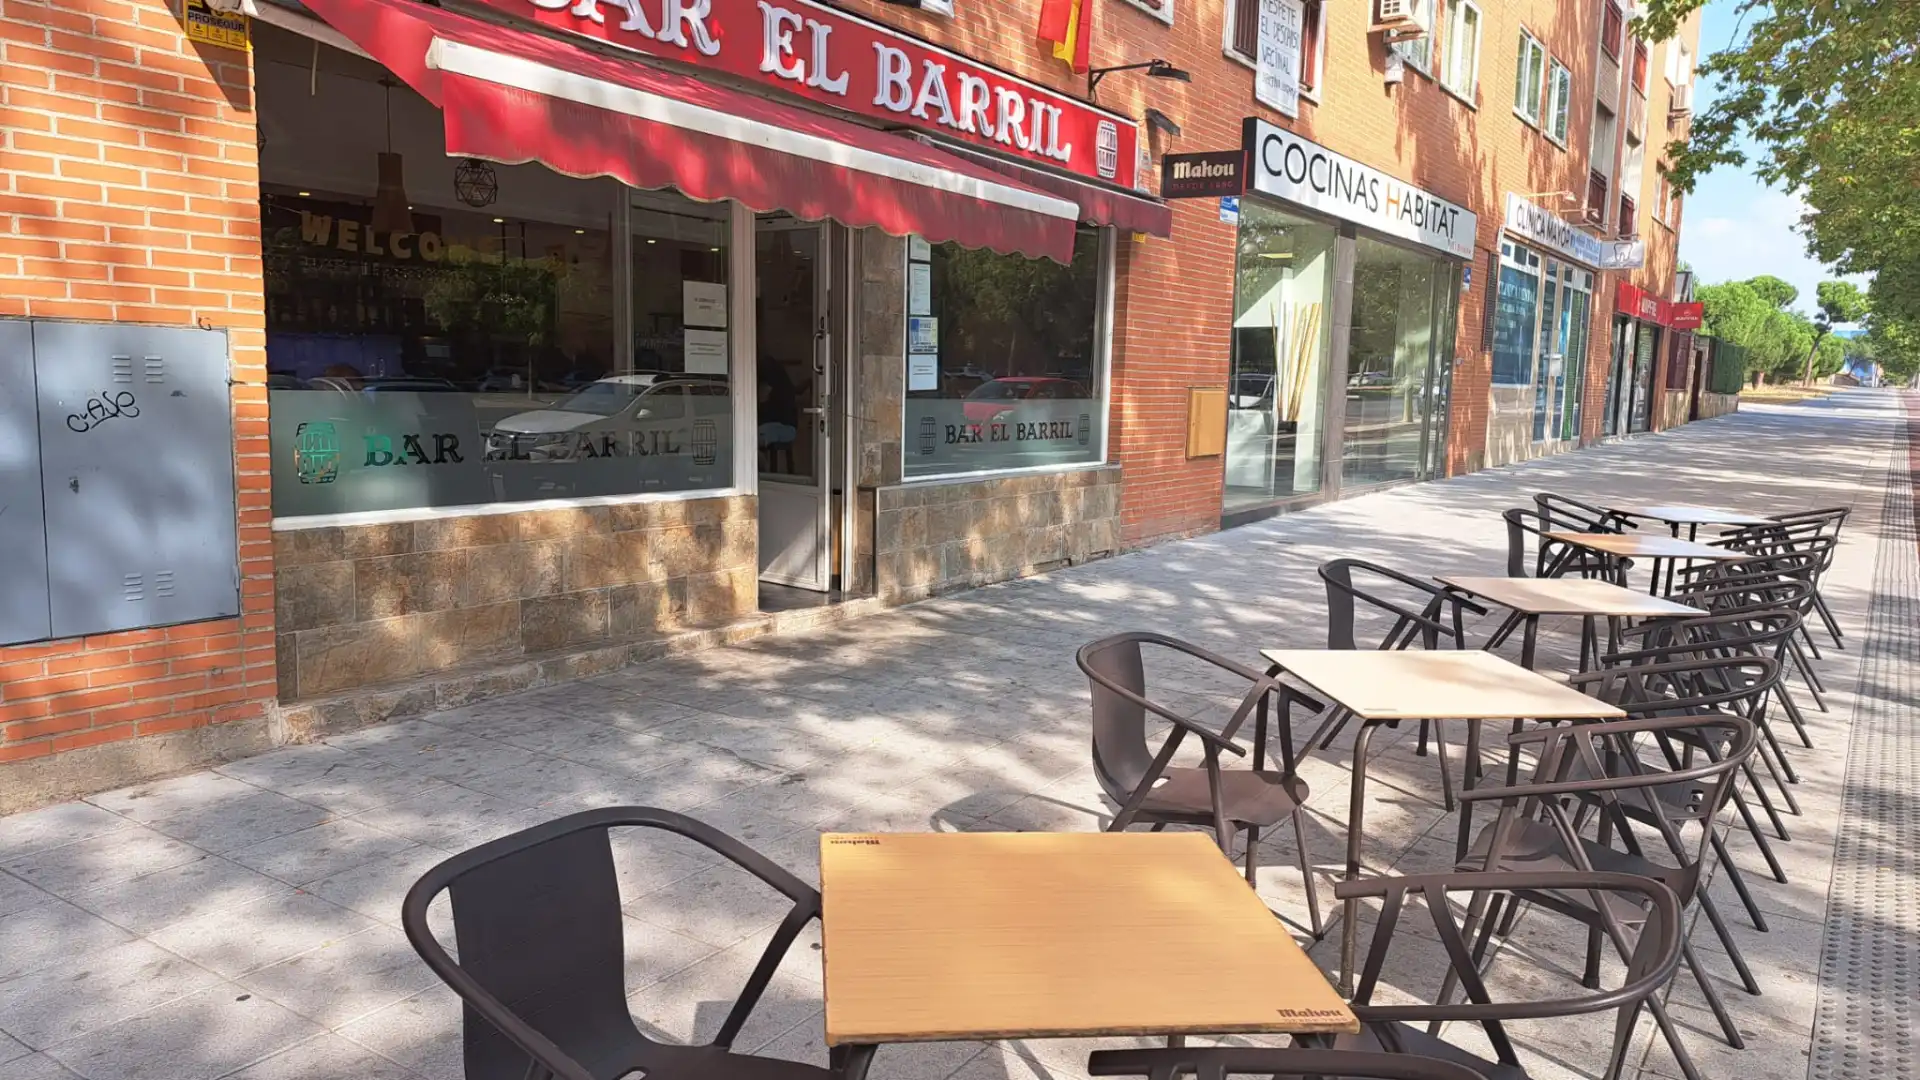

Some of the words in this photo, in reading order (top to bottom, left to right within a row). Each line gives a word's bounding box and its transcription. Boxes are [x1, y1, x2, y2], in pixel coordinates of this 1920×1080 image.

[188, 11, 245, 32] PROSEGUR
[757, 0, 849, 96] EL
[872, 41, 1072, 163] BARRIL
[1173, 160, 1235, 180] Mahou
[1262, 133, 1379, 213] COCINAS
[1386, 182, 1459, 240] HABITAT
[944, 424, 984, 444] BAR
[990, 423, 1010, 442] EL
[1016, 421, 1073, 441] BARRIL
[363, 433, 464, 467] BAR
